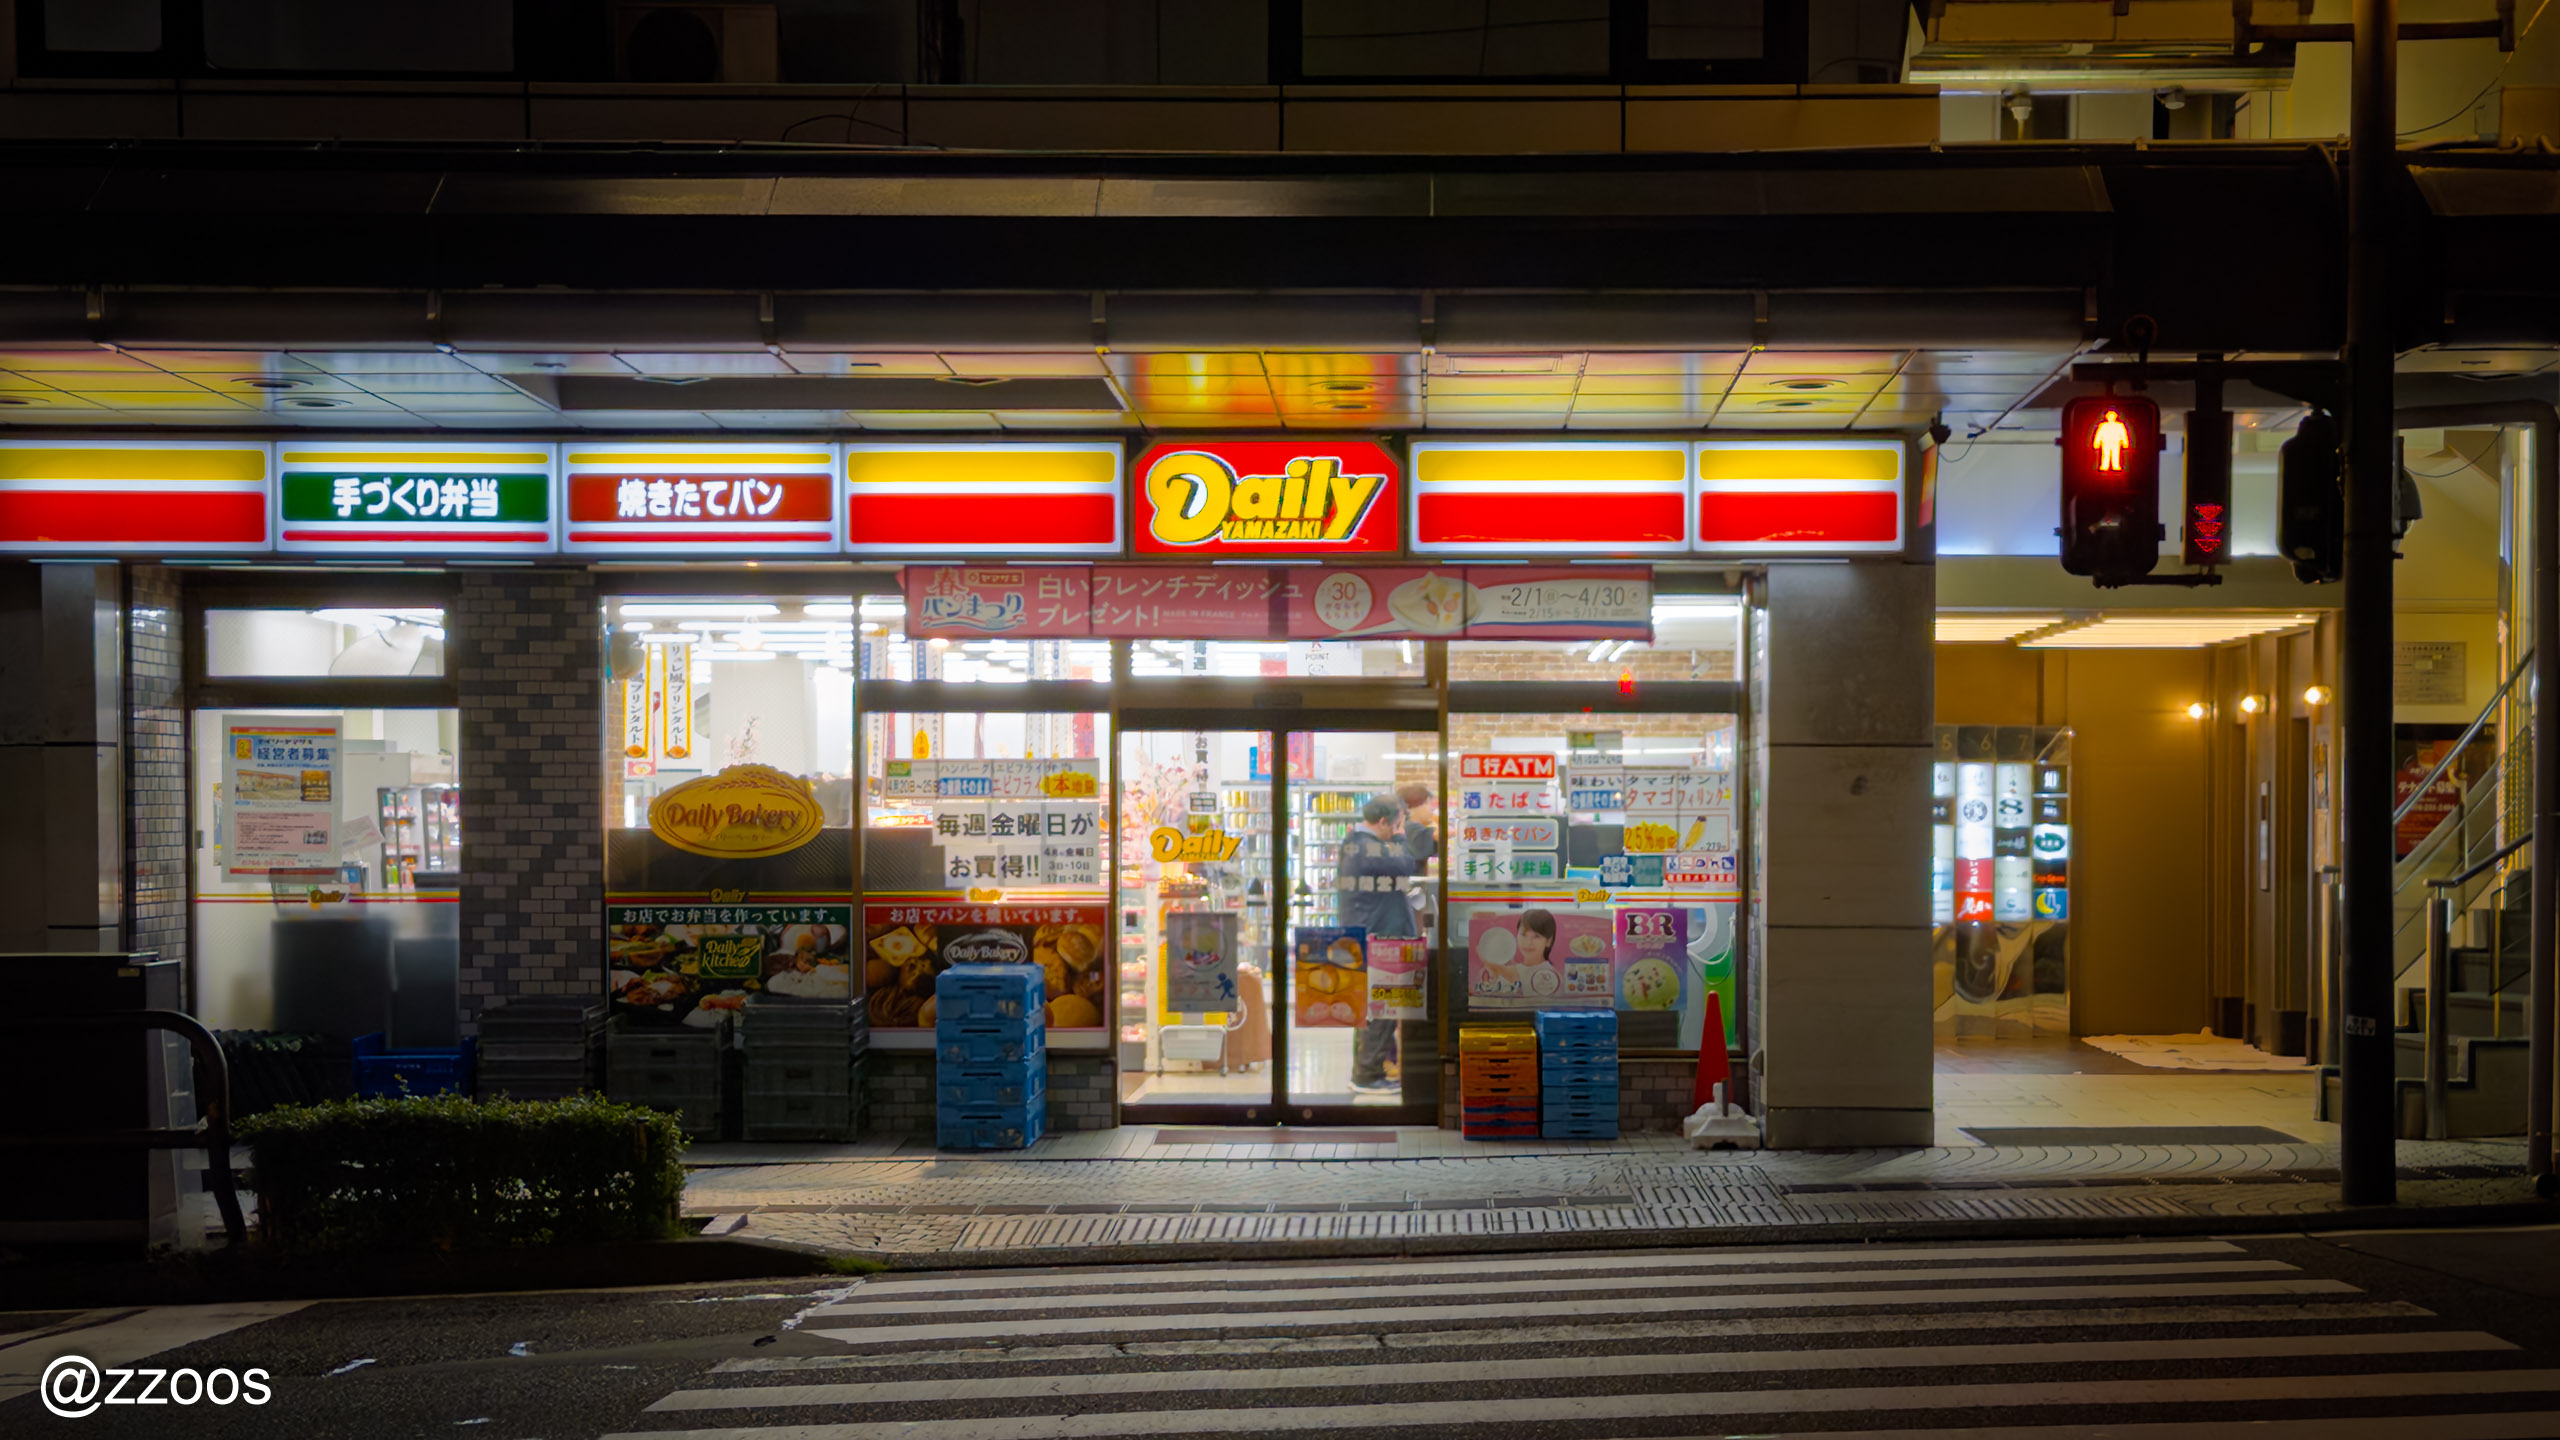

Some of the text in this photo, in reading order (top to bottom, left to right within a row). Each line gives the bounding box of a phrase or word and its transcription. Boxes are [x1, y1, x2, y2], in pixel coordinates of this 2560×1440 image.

[332, 478, 499, 518] 手づくり弁当
[617, 478, 782, 517] 焼きたてパン
[1147, 452, 1385, 544] Daily
[1221, 520, 1322, 540] YAMAZAKI
[1332, 581, 1356, 601] 30
[922, 593, 1023, 618] パンまつり
[257, 747, 331, 761] 経営者募集
[1462, 757, 1554, 776] 銀行ATM
[1464, 792, 1552, 809] 酒 たばこ
[667, 802, 802, 833] Daily Bakery
[936, 813, 1094, 838] 毎週金曜日が
[1463, 825, 1552, 842] 焼きたてパン
[1150, 827, 1243, 863] Daily
[949, 854, 1039, 878] お買得!!
[1463, 860, 1552, 877] 手づくり弁当
[711, 888, 746, 903] Daily
[623, 908, 838, 924] お店でお弁当を作っています。
[890, 908, 1085, 924] お店でパンを焼いています。
